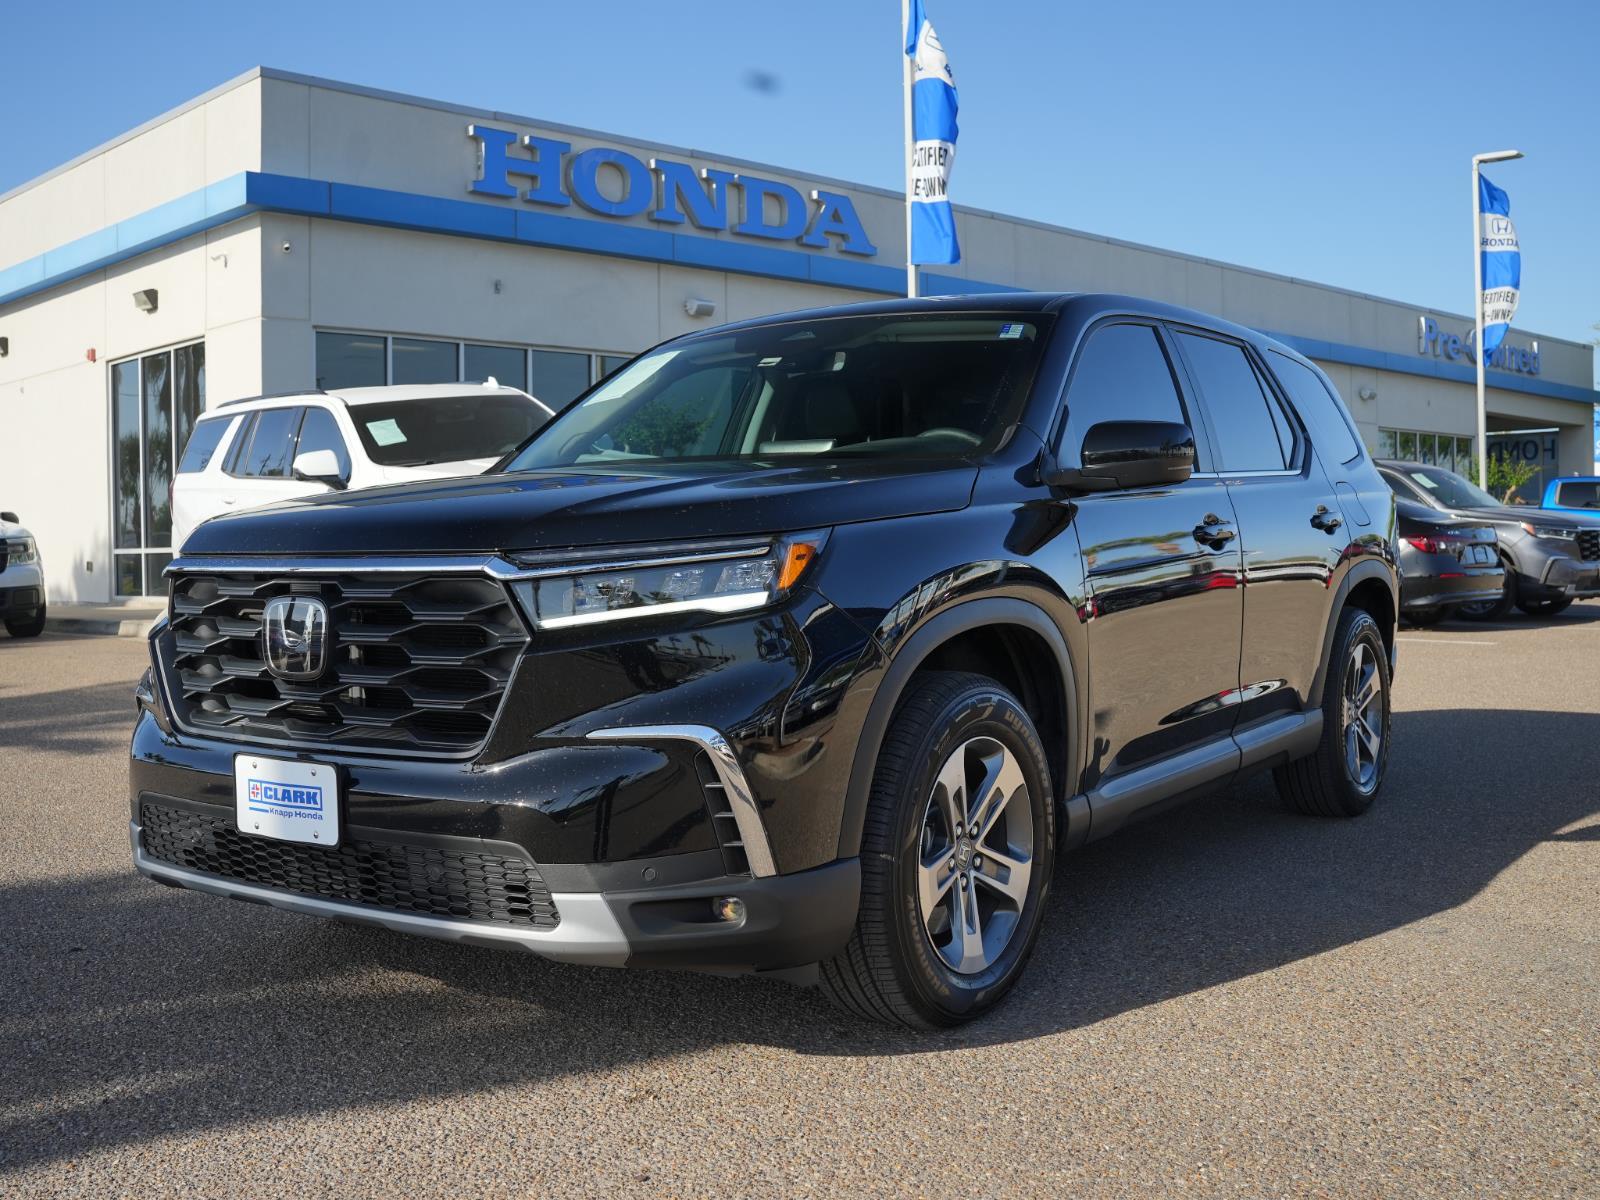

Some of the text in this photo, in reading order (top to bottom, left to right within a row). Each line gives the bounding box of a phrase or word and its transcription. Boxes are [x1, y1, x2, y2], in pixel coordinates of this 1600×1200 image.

[467, 124, 877, 256] HONDA
[263, 786, 319, 806] CLARK
[269, 807, 323, 821] Knapp Honda
